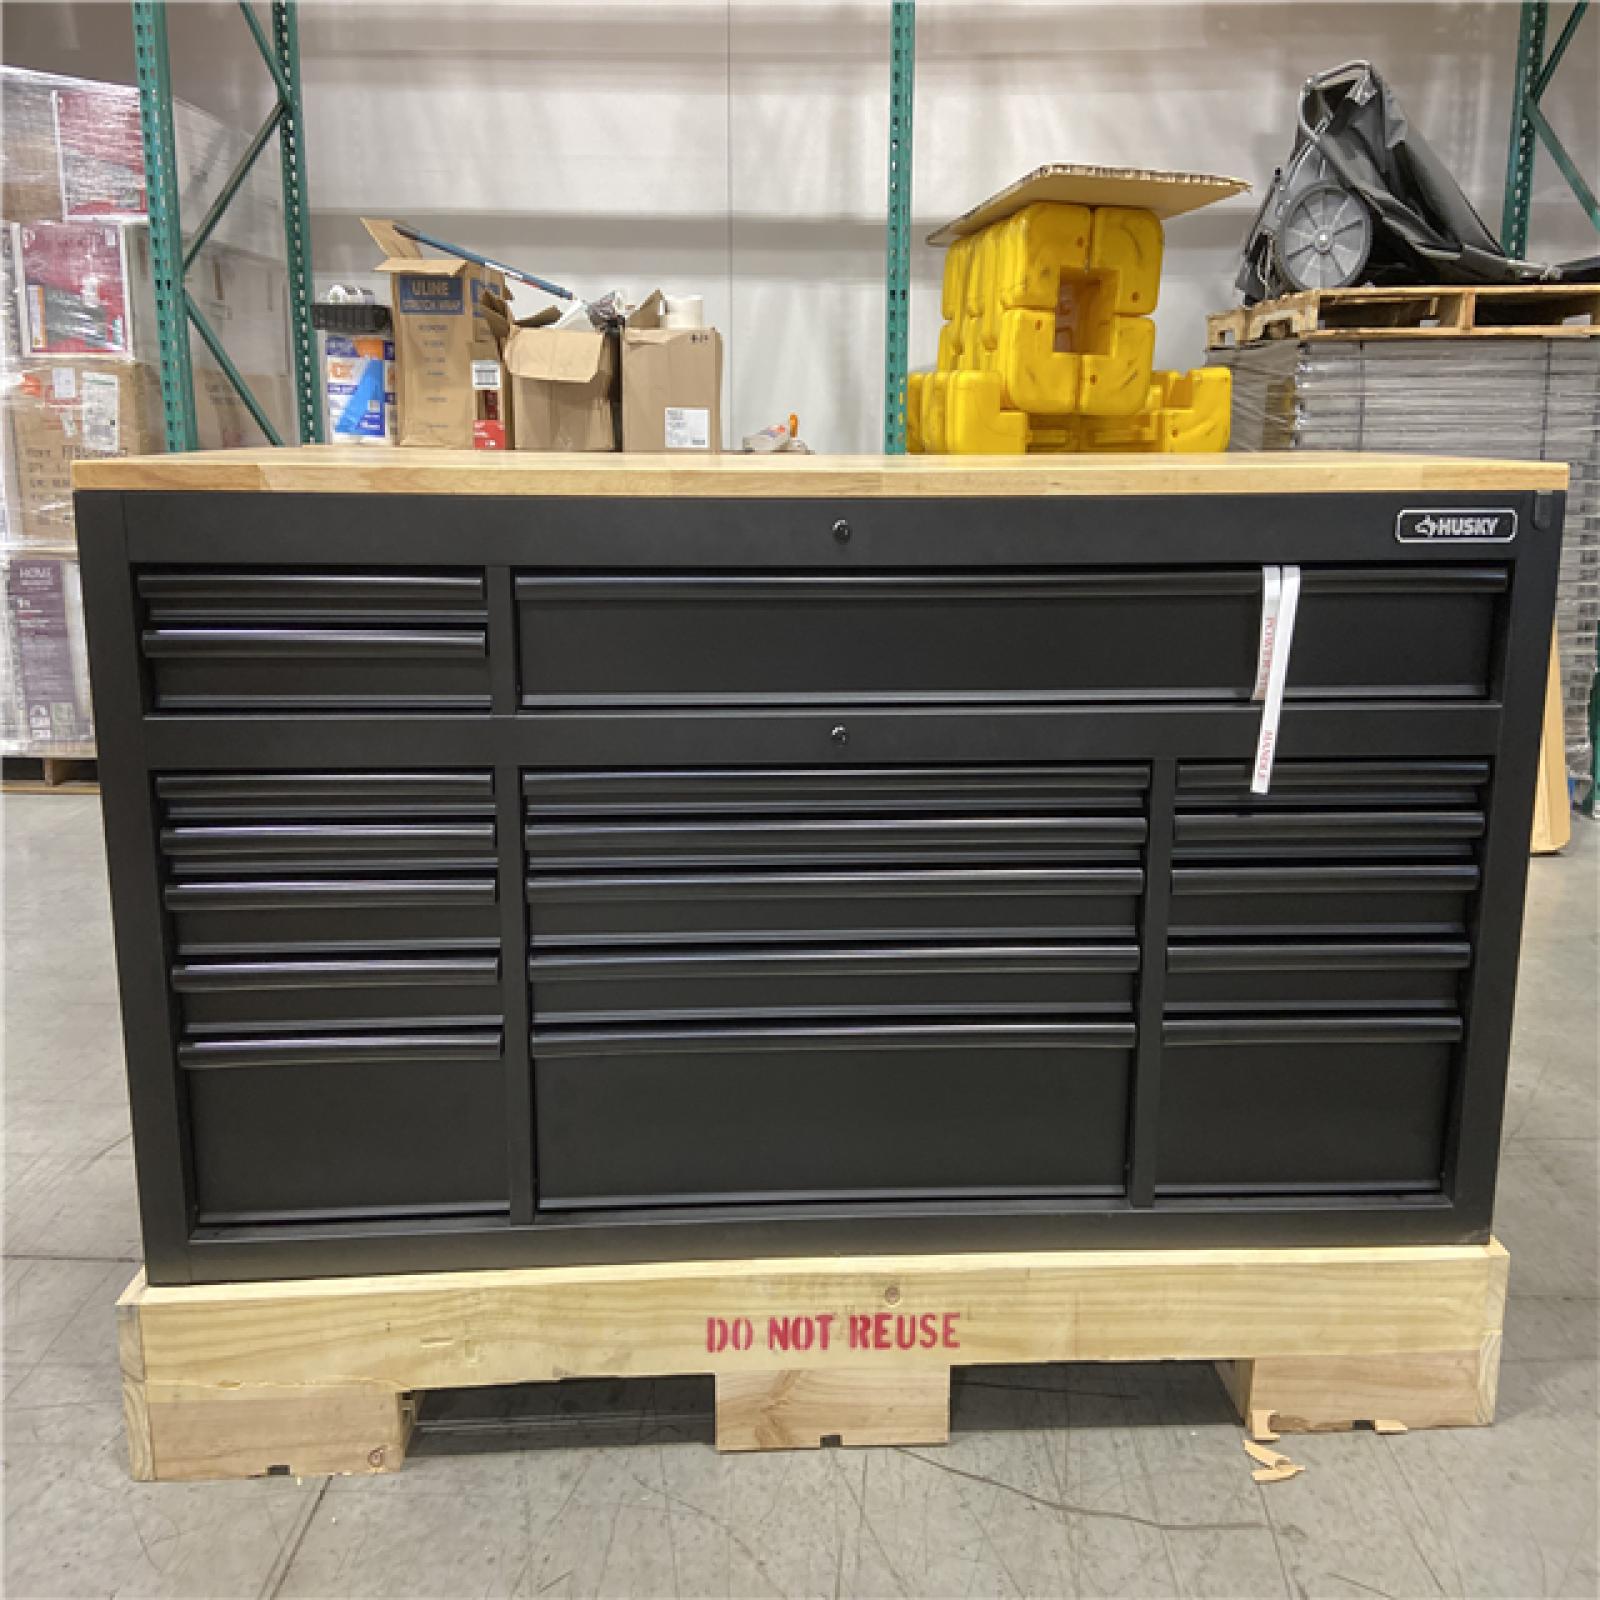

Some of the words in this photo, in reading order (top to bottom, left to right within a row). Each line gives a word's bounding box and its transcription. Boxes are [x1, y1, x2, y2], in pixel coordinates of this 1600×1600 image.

[1438, 516, 1499, 536] HUSKY
[706, 1316, 753, 1353] DO
[768, 1312, 835, 1351] NOT
[848, 1312, 961, 1350] REUSE
